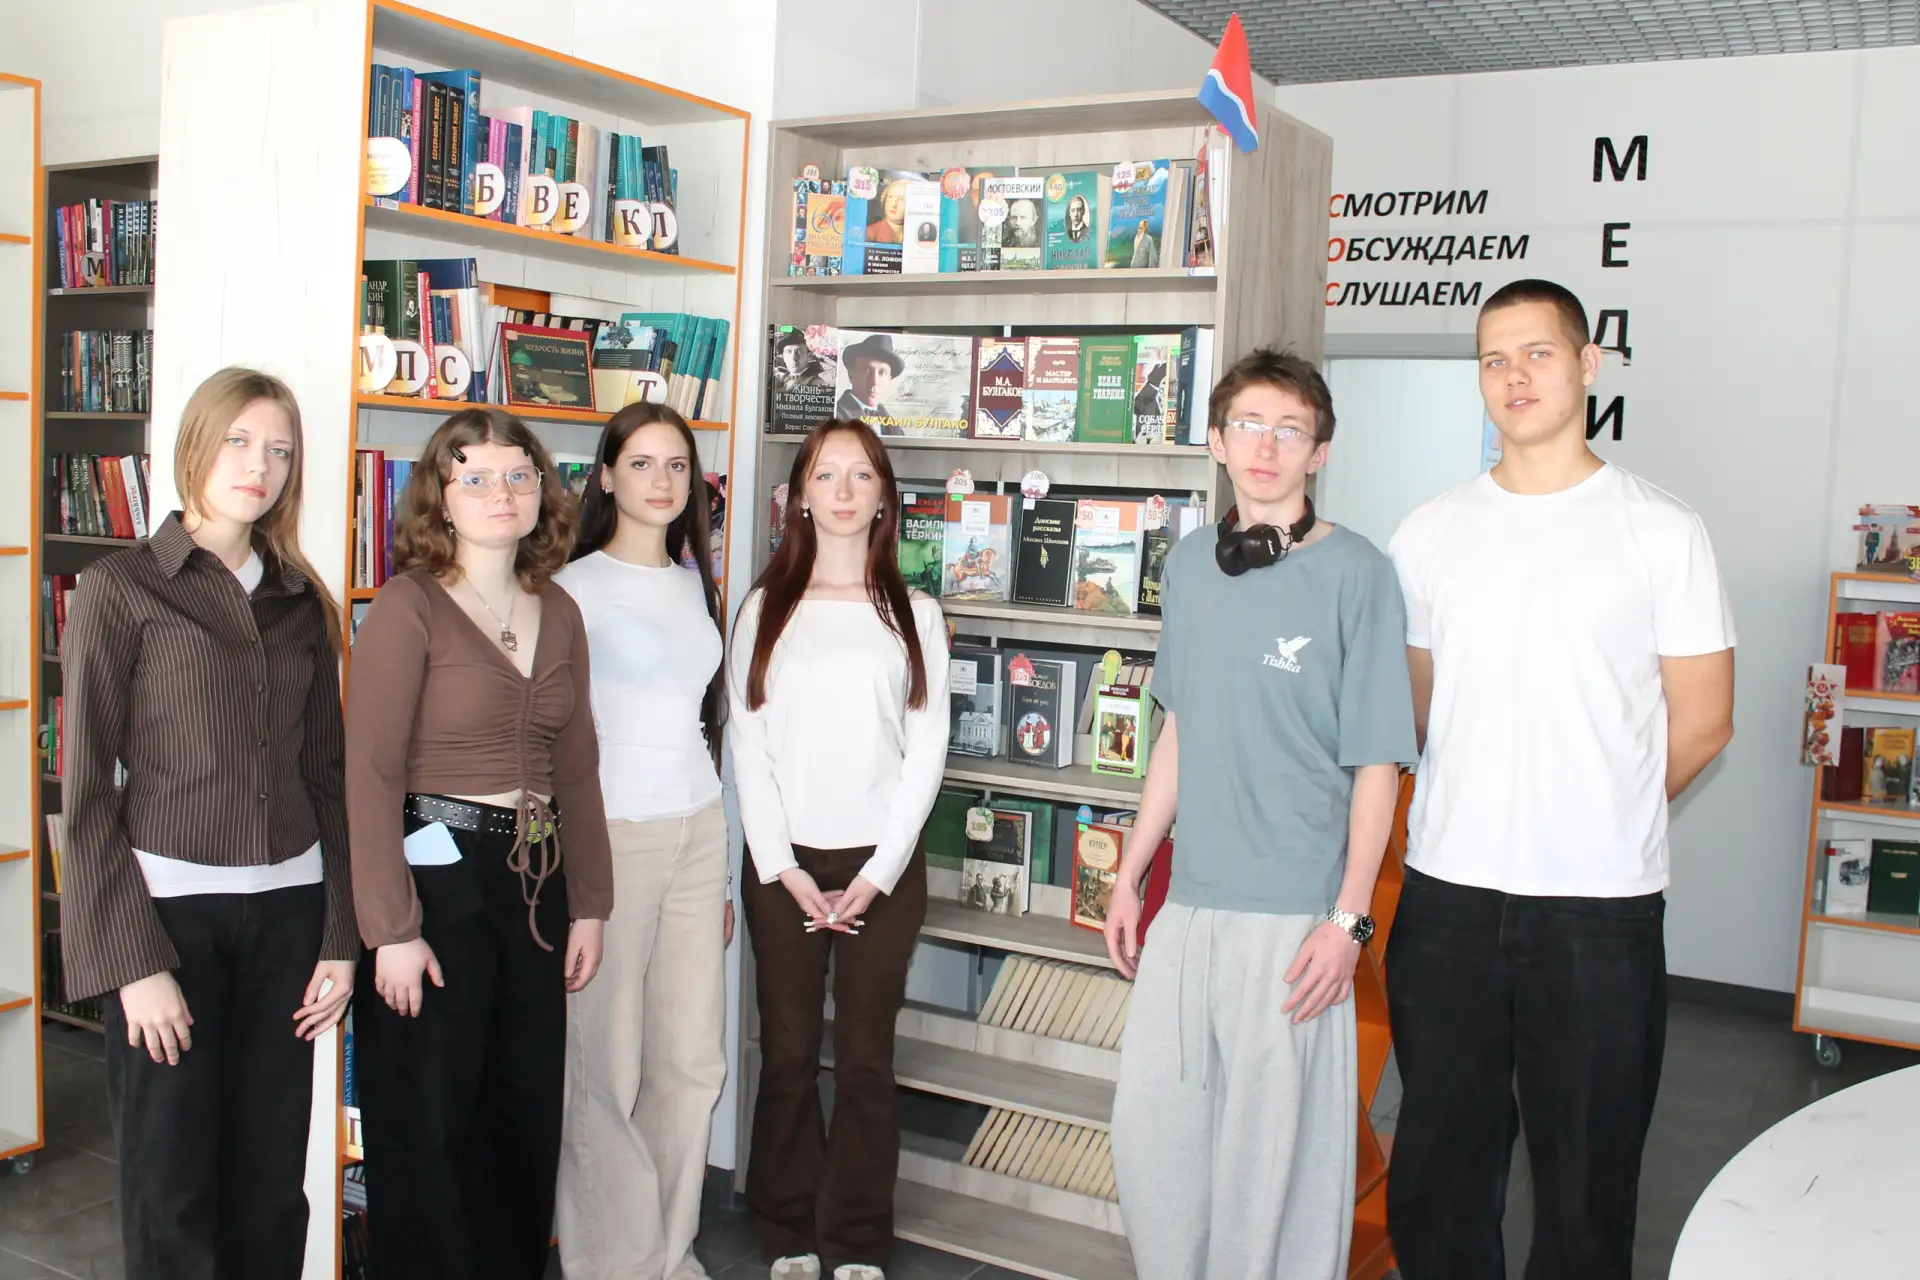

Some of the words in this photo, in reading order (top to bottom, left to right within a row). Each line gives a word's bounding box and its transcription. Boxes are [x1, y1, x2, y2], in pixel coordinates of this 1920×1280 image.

[1116, 170, 1132, 179] 125
[477, 174, 494, 203] Б
[533, 186, 549, 213] В
[564, 192, 580, 220] Е
[1328, 189, 1489, 218] СМОТРИМ
[620, 208, 642, 236] К
[652, 211, 669, 238] Л
[1327, 234, 1530, 266] ОБСУЖДАЕМ
[86, 257, 105, 278] М
[1325, 281, 1483, 307] СЛУШАЕМ
[525, 343, 560, 354] МУДРОСТЬ
[560, 347, 584, 357] ЖИЗНИ
[396, 351, 416, 381] П
[440, 356, 458, 385] С
[1045, 370, 1072, 378] МАСТЕР
[995, 377, 1012, 387] М.А.
[1098, 375, 1122, 387] БЕЛАЯ
[637, 380, 657, 403] Т
[792, 383, 821, 395] Жизнь
[982, 386, 1023, 397] БУЛГАКОВ
[1093, 388, 1125, 400] ГВАРДИЯ
[783, 394, 835, 404] творчество
[805, 404, 834, 413] Булгакова
[784, 423, 802, 431] Борис
[859, 415, 914, 428] МИХАИЛ
[914, 417, 968, 429] БУЛГАКО
[954, 477, 968, 486] 205
[1034, 517, 1061, 525] Донские
[906, 528, 944, 541] ТЁРКИН
[1032, 525, 1061, 533] рассказы
[1043, 538, 1069, 546] Шолохов
[1262, 653, 1301, 673] Tishka
